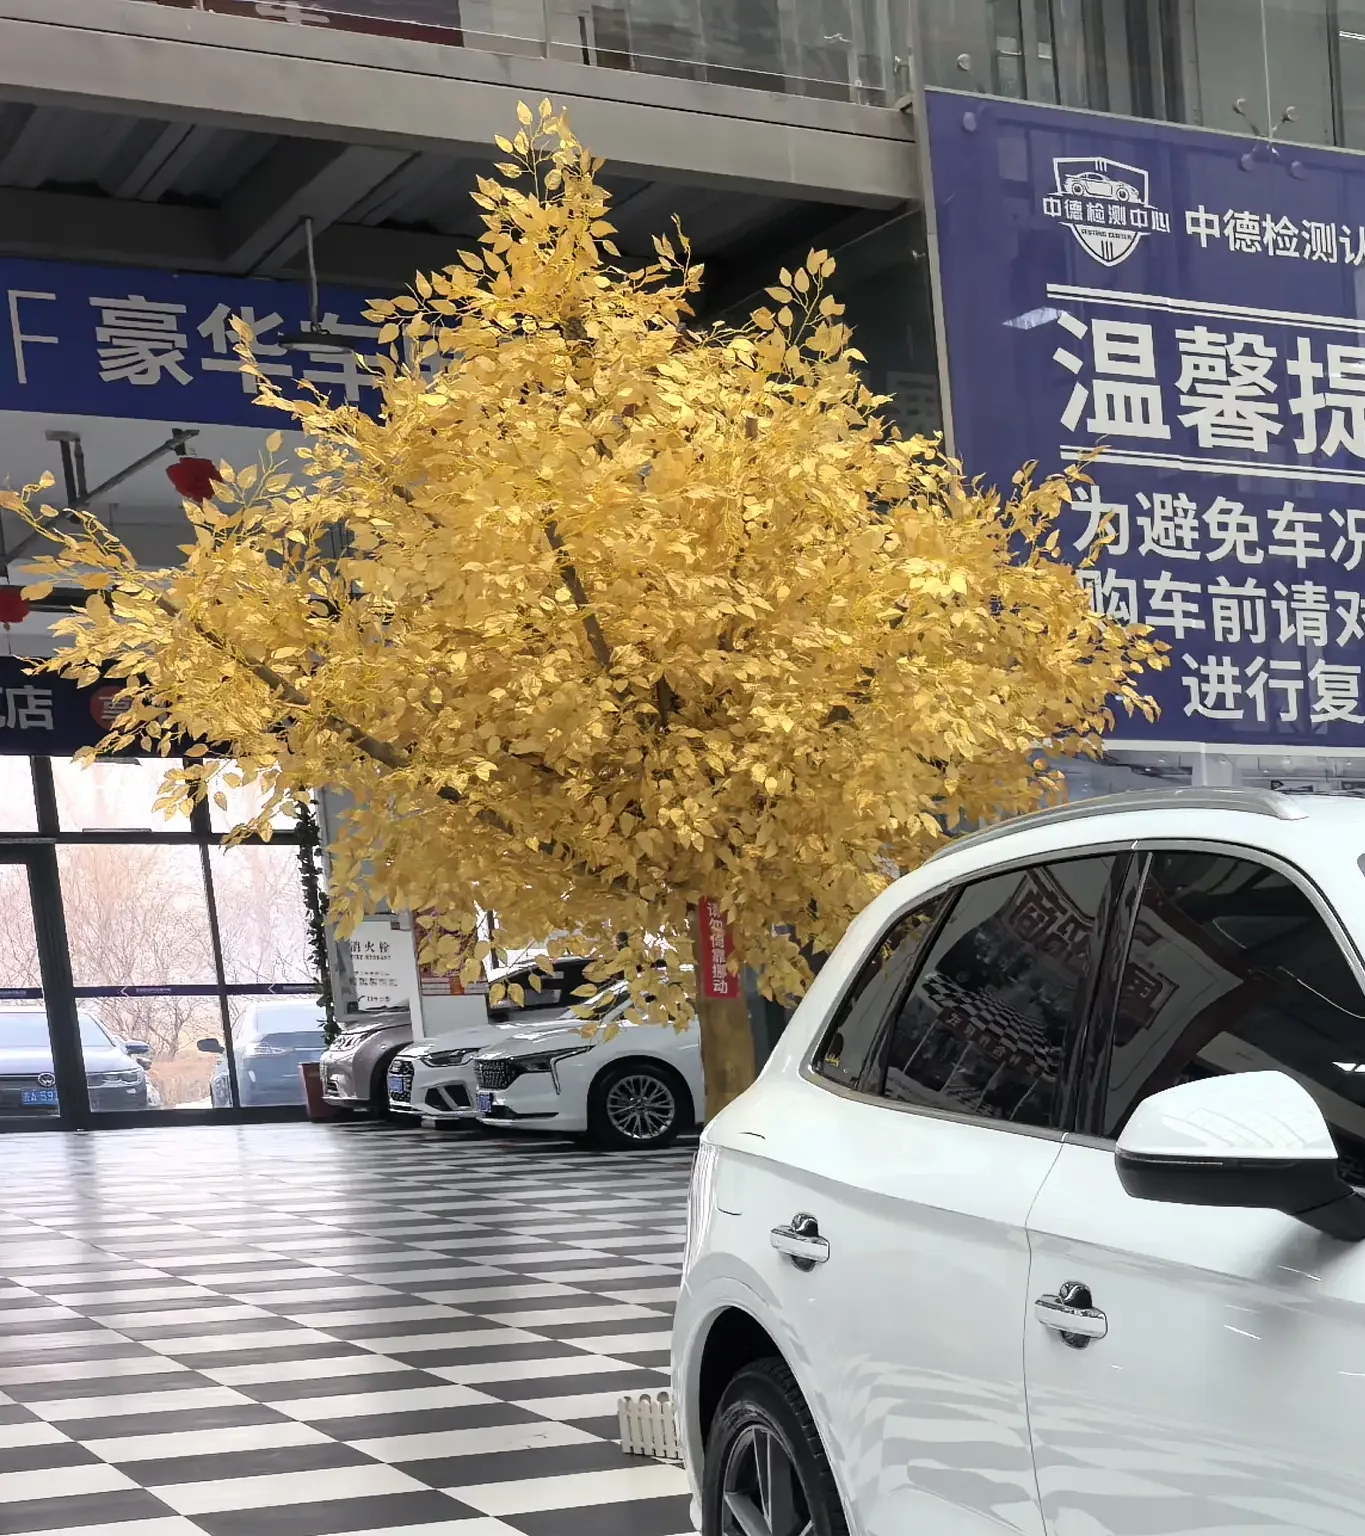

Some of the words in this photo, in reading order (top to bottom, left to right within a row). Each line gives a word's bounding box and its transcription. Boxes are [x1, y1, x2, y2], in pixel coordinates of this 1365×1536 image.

[1043, 197, 1171, 233] 中德检测中心
[89, 295, 450, 402] 豪华车
[0, 685, 54, 730] 店
